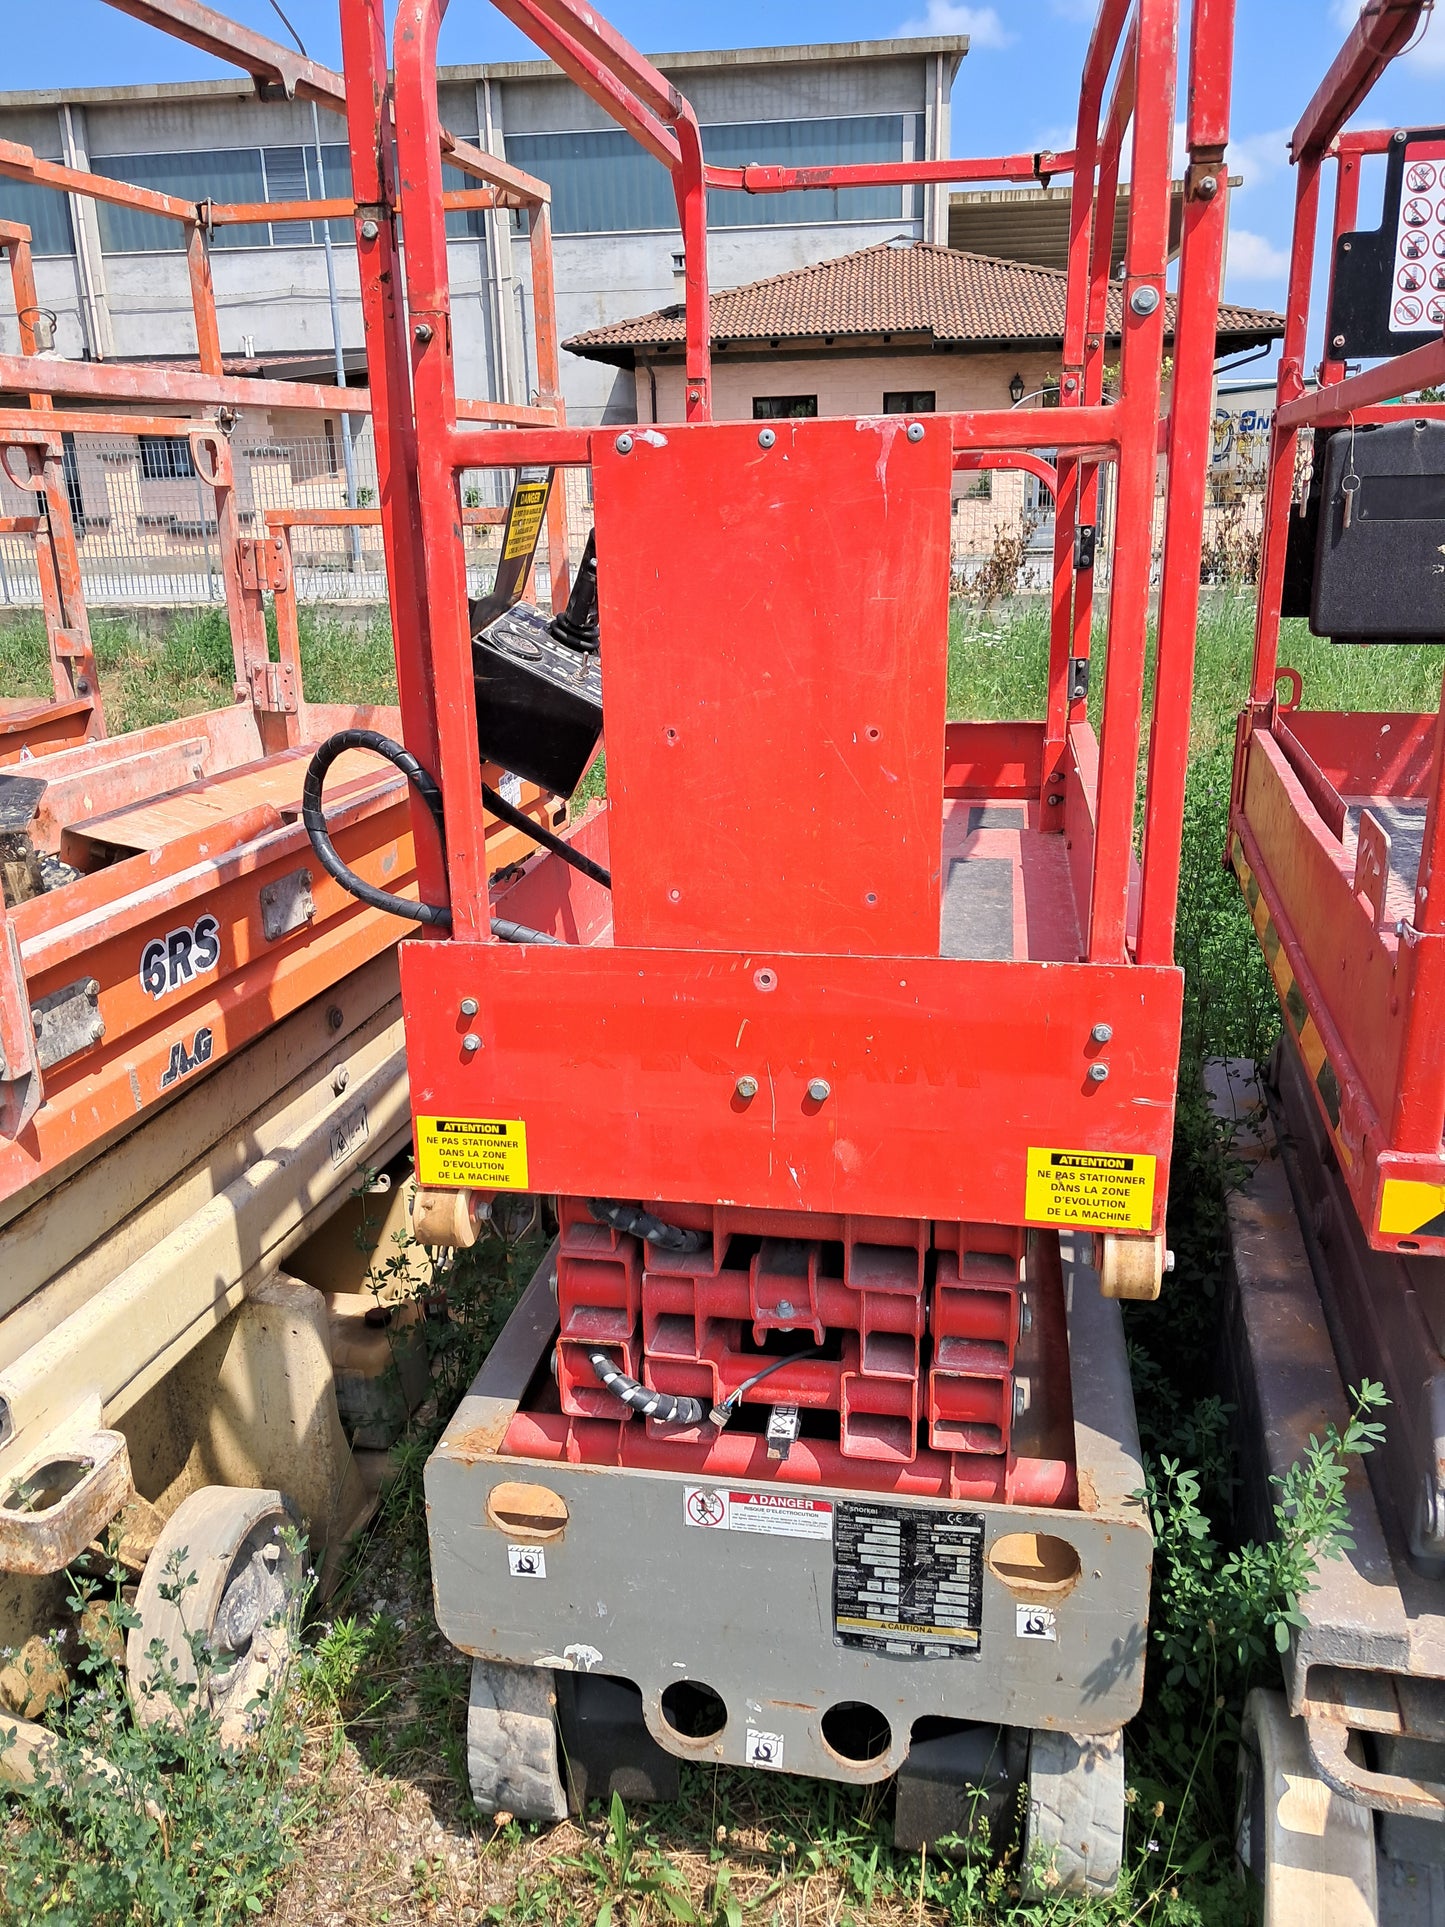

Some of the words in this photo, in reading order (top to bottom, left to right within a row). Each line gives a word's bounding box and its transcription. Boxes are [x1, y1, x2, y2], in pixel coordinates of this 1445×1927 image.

[520, 491, 541, 505] DANGER
[141, 915, 220, 999] 6RS
[443, 1123, 500, 1133] ATTENTION
[426, 1136, 439, 1144] NE
[442, 1137, 459, 1145] PAS
[462, 1138, 518, 1148] STATIONNER
[439, 1149, 465, 1157] DANS
[468, 1150, 479, 1158] LA
[482, 1151, 507, 1159] ZONE
[443, 1160, 504, 1170] D'EVOLUTION
[1059, 1156, 1125, 1168] ATTENTION
[438, 1171, 450, 1179] DE
[453, 1172, 465, 1180] LA
[468, 1173, 510, 1182] MACHINE
[1037, 1170, 1051, 1178] NE
[1055, 1171, 1076, 1180] PAS
[1079, 1172, 1145, 1185] STATIONNER
[1051, 1183, 1081, 1193] DANS
[1084, 1186, 1097, 1194] LA
[1102, 1187, 1131, 1197] ZONE
[1054, 1195, 1126, 1208] D'EVOLUTION
[1047, 1207, 1061, 1216] DE
[1064, 1209, 1078, 1217] LA
[1081, 1210, 1131, 1221] MACHINE
[760, 1495, 814, 1510] DANGER
[888, 1623, 926, 1633] CAUTION
